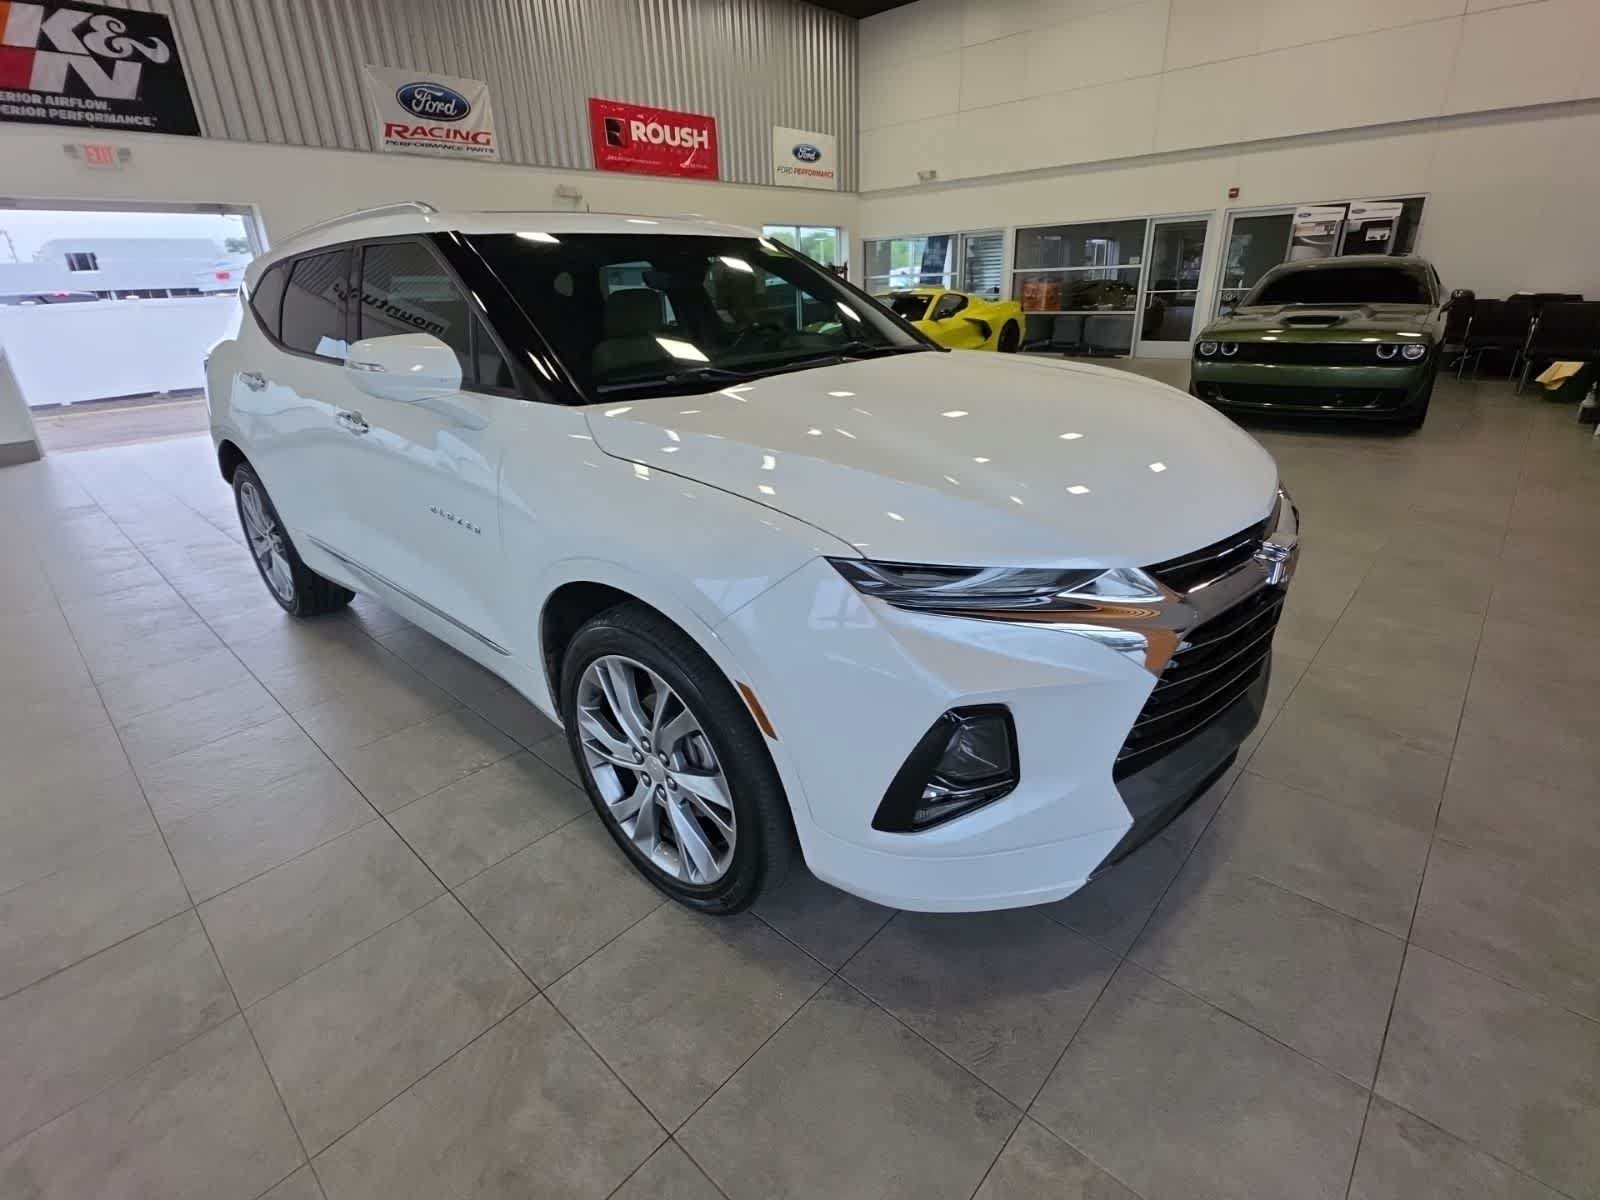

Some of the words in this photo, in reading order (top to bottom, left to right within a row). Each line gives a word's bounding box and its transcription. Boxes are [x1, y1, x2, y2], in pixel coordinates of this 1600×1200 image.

[46, 95, 111, 111] AIRFLOW.
[411, 87, 458, 116] Ford
[384, 122, 492, 146] RACING
[386, 140, 464, 151] PERFORMANCE
[630, 120, 709, 150] ROUSH
